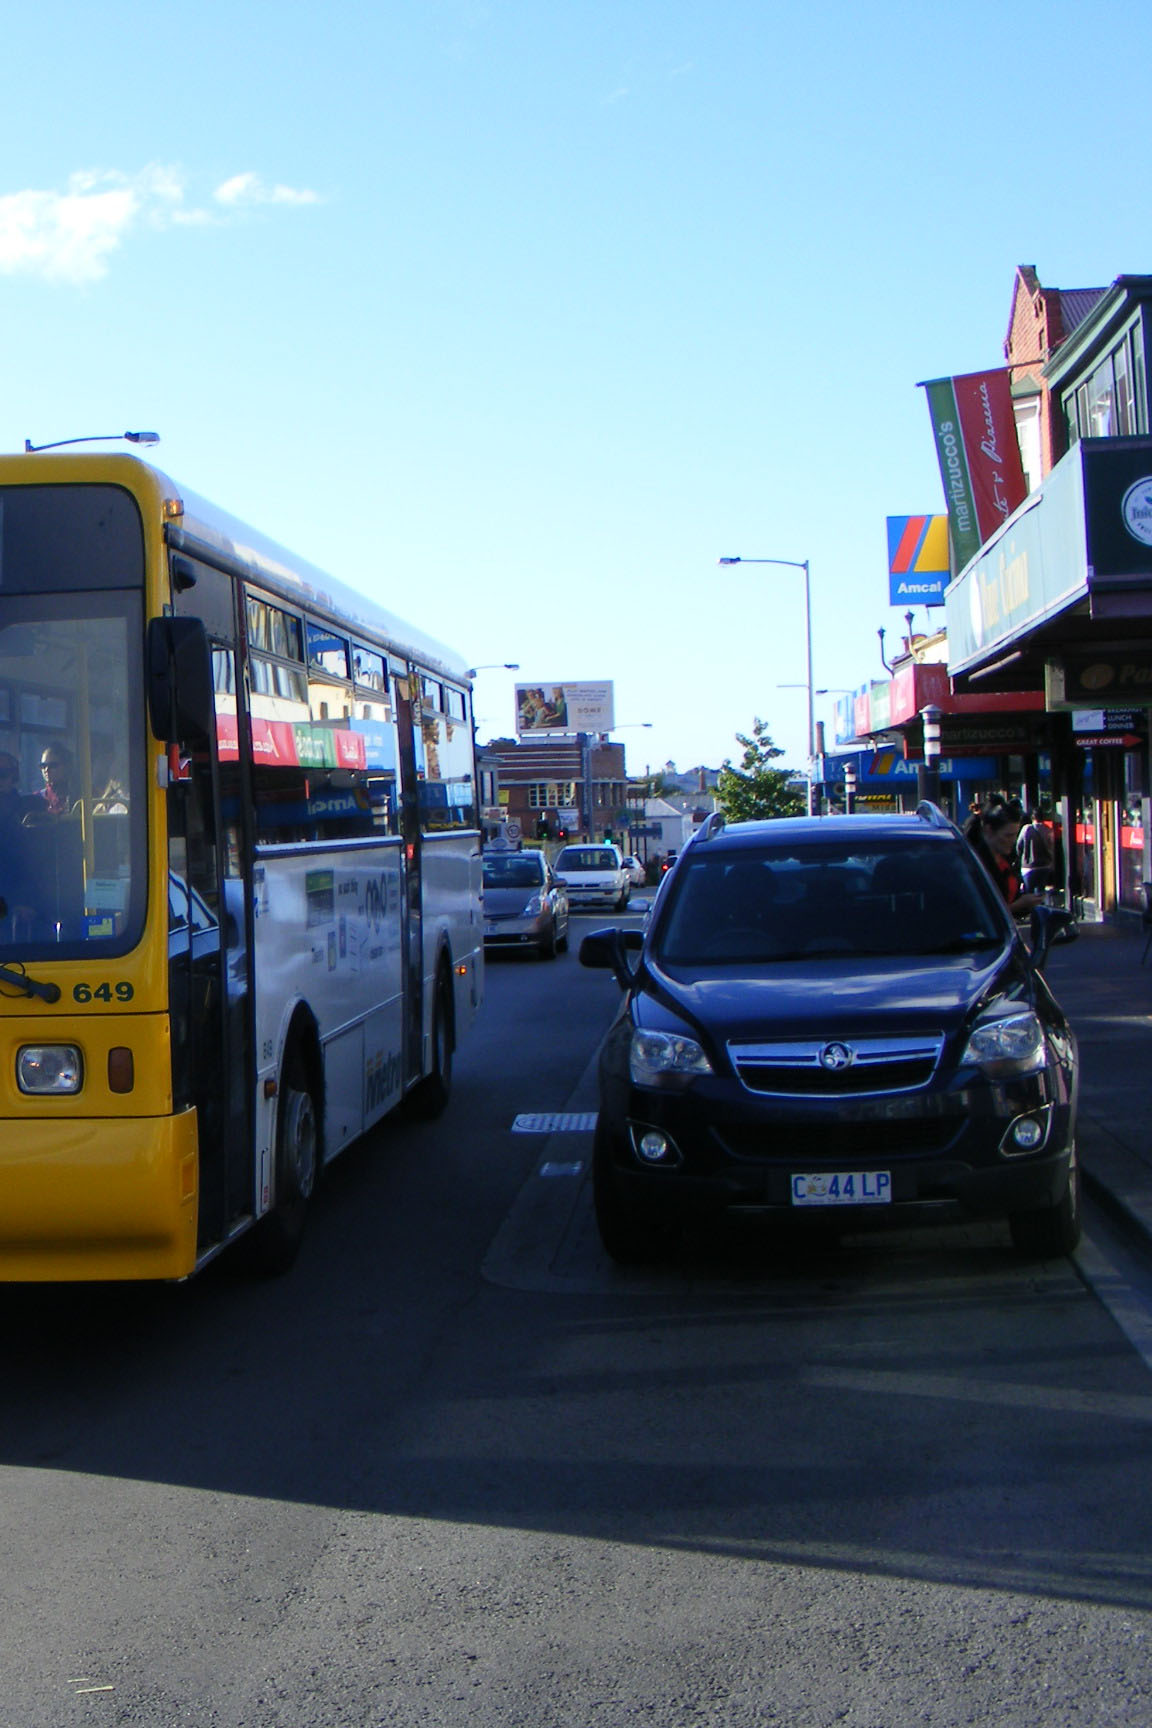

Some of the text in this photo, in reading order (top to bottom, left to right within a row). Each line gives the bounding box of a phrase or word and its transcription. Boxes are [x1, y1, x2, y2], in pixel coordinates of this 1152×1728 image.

[938, 421, 971, 532] martizucco's
[897, 581, 942, 594] Amcal
[1076, 737, 1123, 746] GREAT COFFEE
[72, 981, 135, 1003] 649
[793, 1173, 890, 1199] C 44 LP
